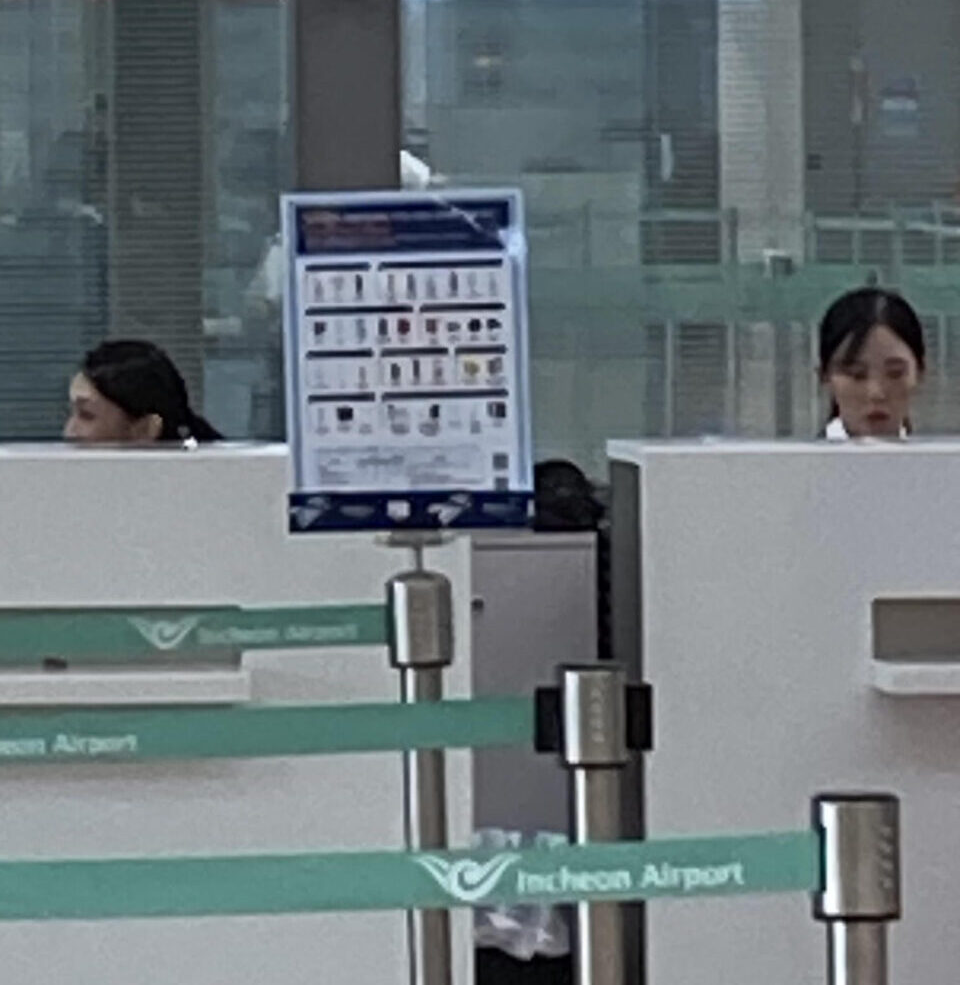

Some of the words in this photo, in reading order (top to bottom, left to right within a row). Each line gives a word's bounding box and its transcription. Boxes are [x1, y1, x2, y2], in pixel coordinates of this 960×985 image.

[52, 732, 138, 756] Airport
[517, 866, 632, 894] Incheon
[641, 861, 745, 892] Airport
